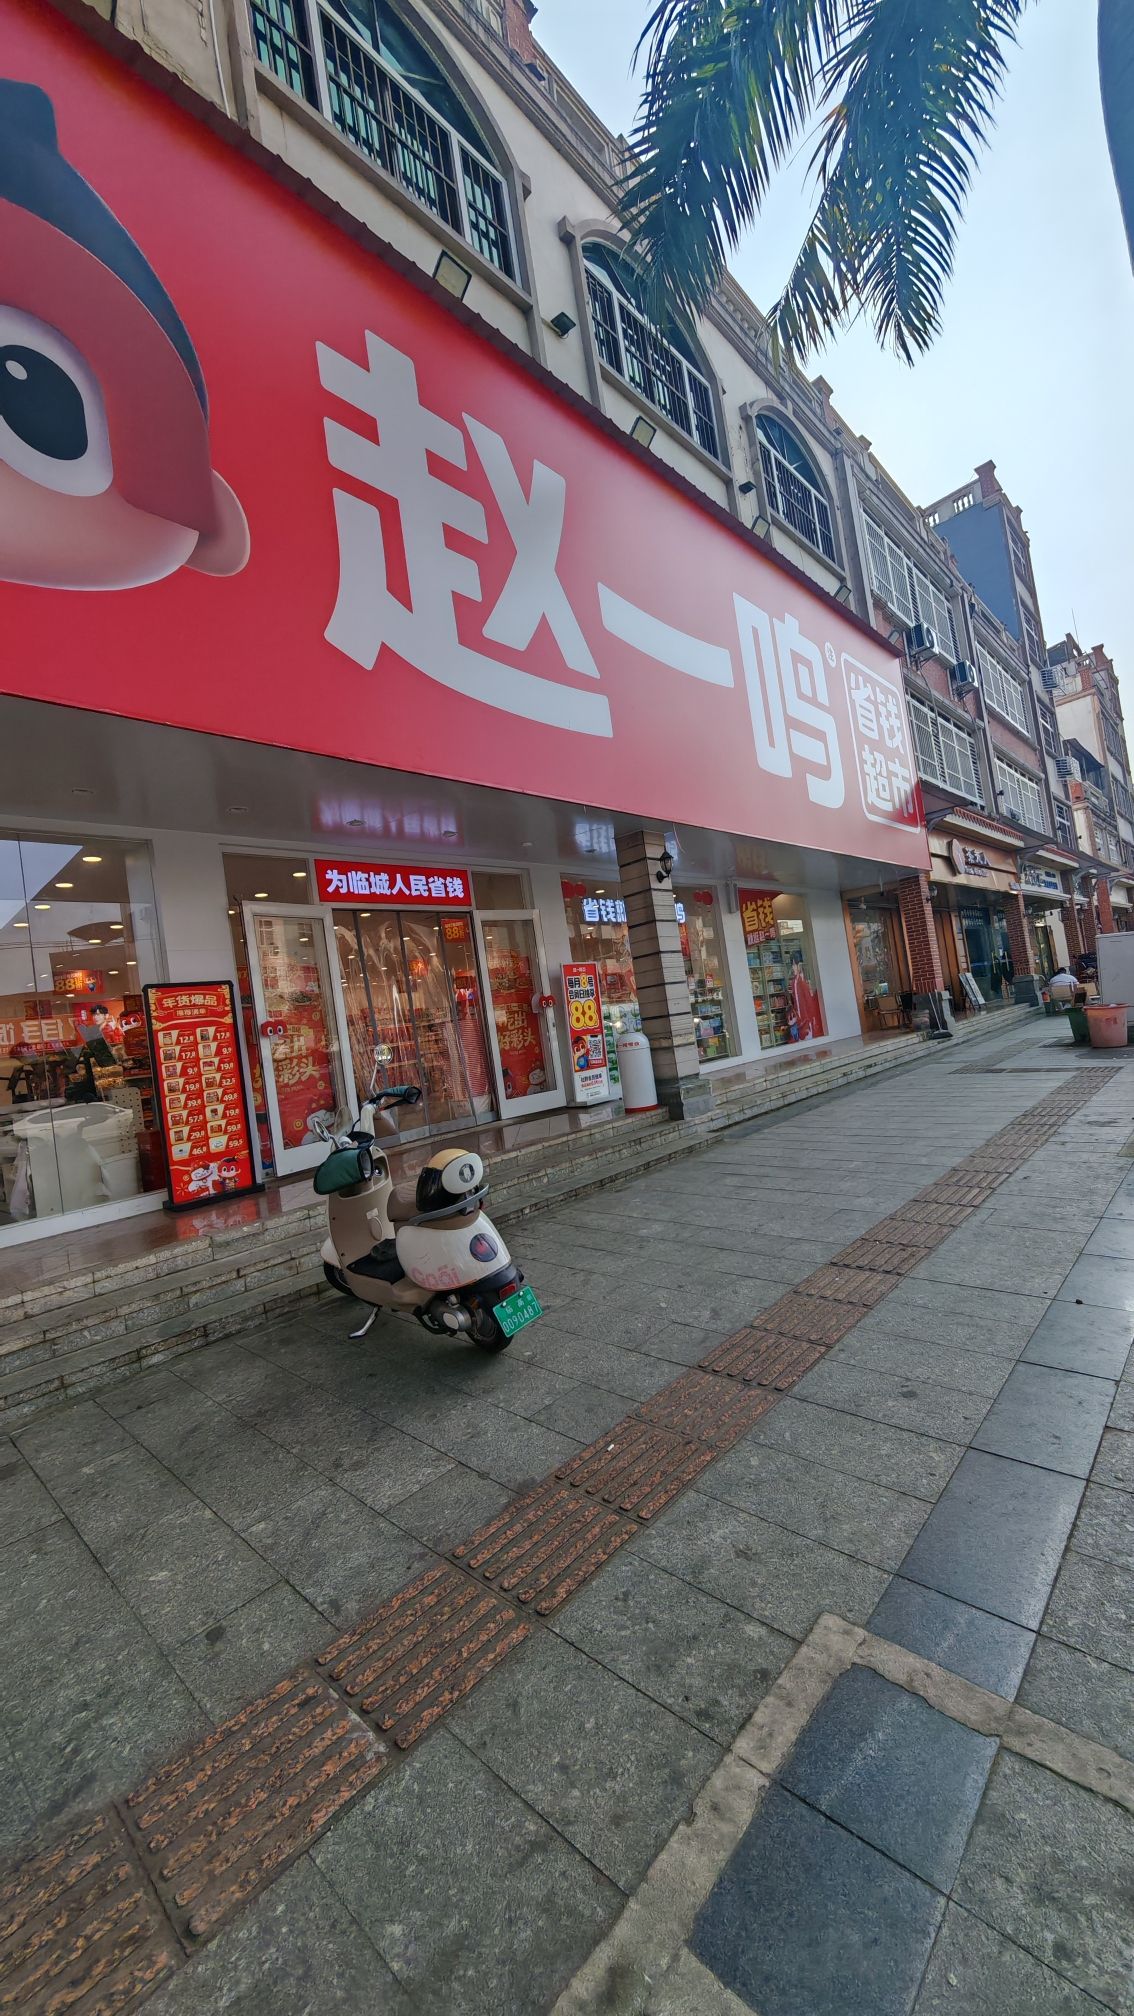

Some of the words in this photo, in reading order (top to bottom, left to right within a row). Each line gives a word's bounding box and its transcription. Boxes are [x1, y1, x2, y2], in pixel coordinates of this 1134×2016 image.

[315, 329, 845, 809] 赵一鸣
[851, 671, 904, 754] 省钱
[862, 745, 914, 818] 超市
[326, 869, 465, 898] 为临城人民省钱
[742, 897, 775, 932] 省钱
[502, 1301, 539, 1332] 0090487
